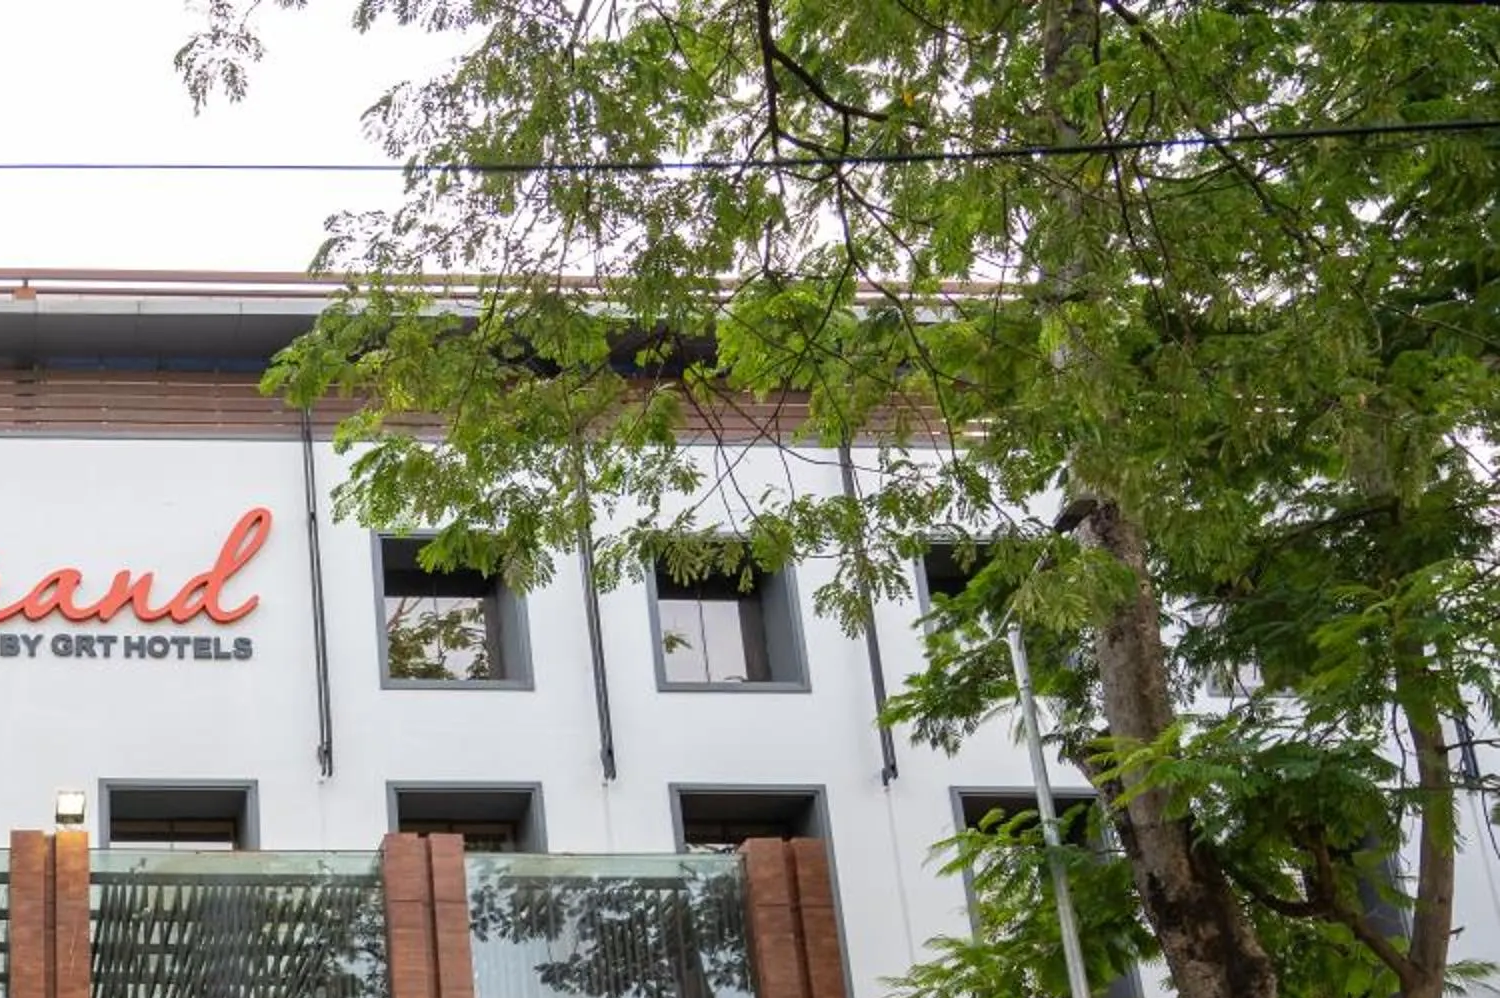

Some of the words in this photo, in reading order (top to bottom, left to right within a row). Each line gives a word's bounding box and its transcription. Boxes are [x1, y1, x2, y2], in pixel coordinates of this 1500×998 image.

[0, 633, 44, 658] BY
[51, 634, 118, 659] GRT
[123, 634, 254, 661] HOTELS
